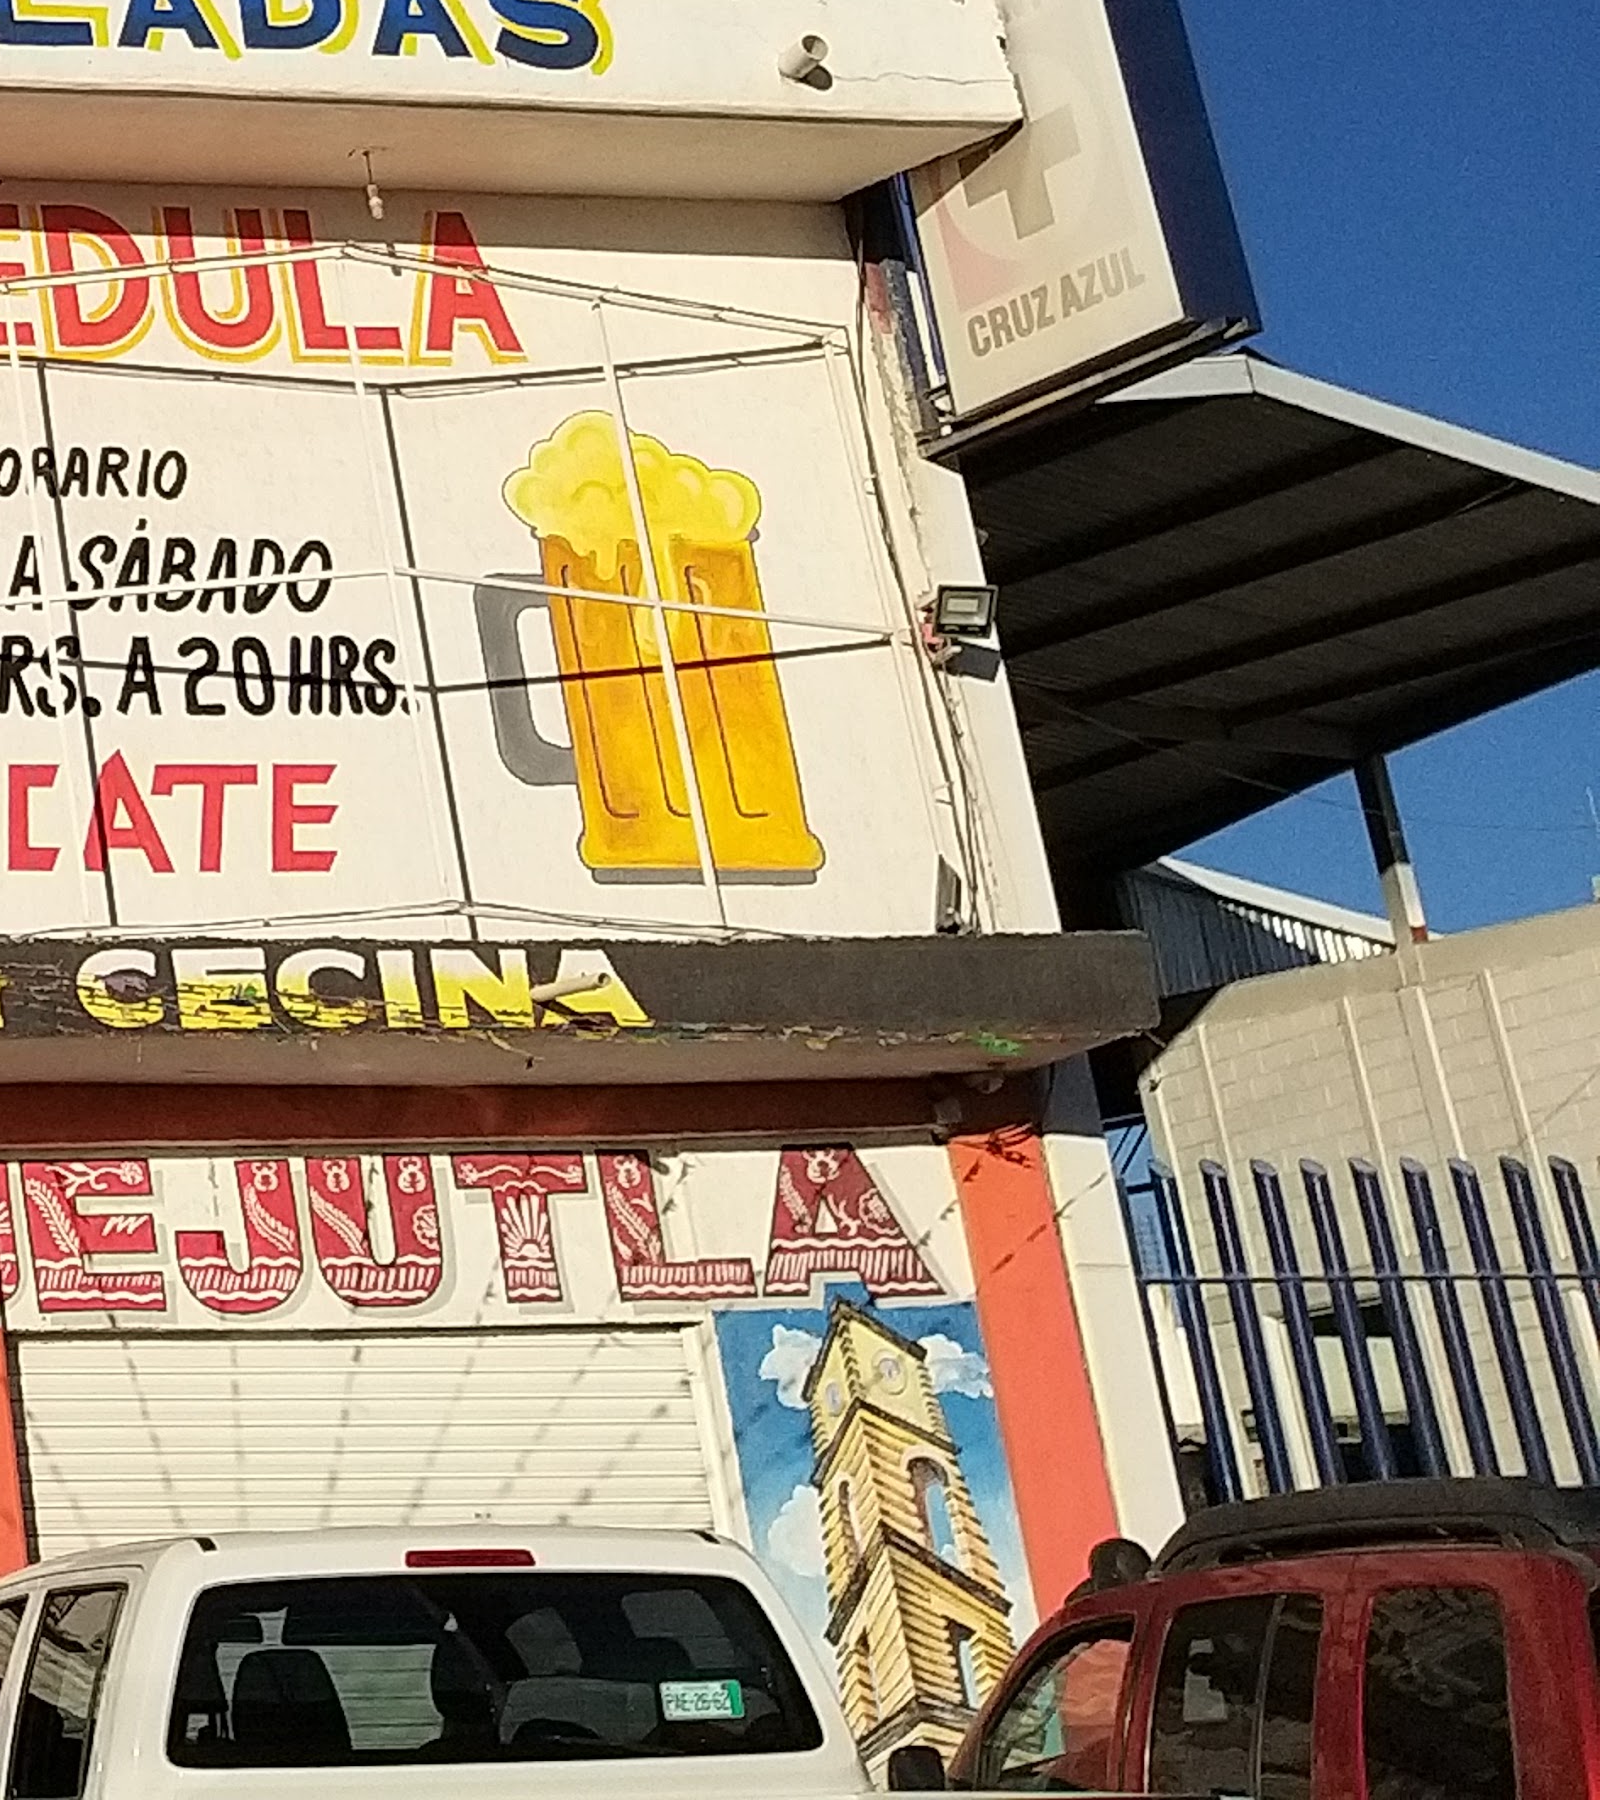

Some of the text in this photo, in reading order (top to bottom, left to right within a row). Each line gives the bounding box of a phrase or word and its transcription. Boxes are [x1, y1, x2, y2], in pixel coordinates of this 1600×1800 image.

[966, 246, 1146, 358] CRUZ AZUL
[4, 534, 42, 613] A
[65, 517, 335, 613] SÁBADO
[119, 637, 162, 715] A
[74, 942, 654, 1032] CECINA
